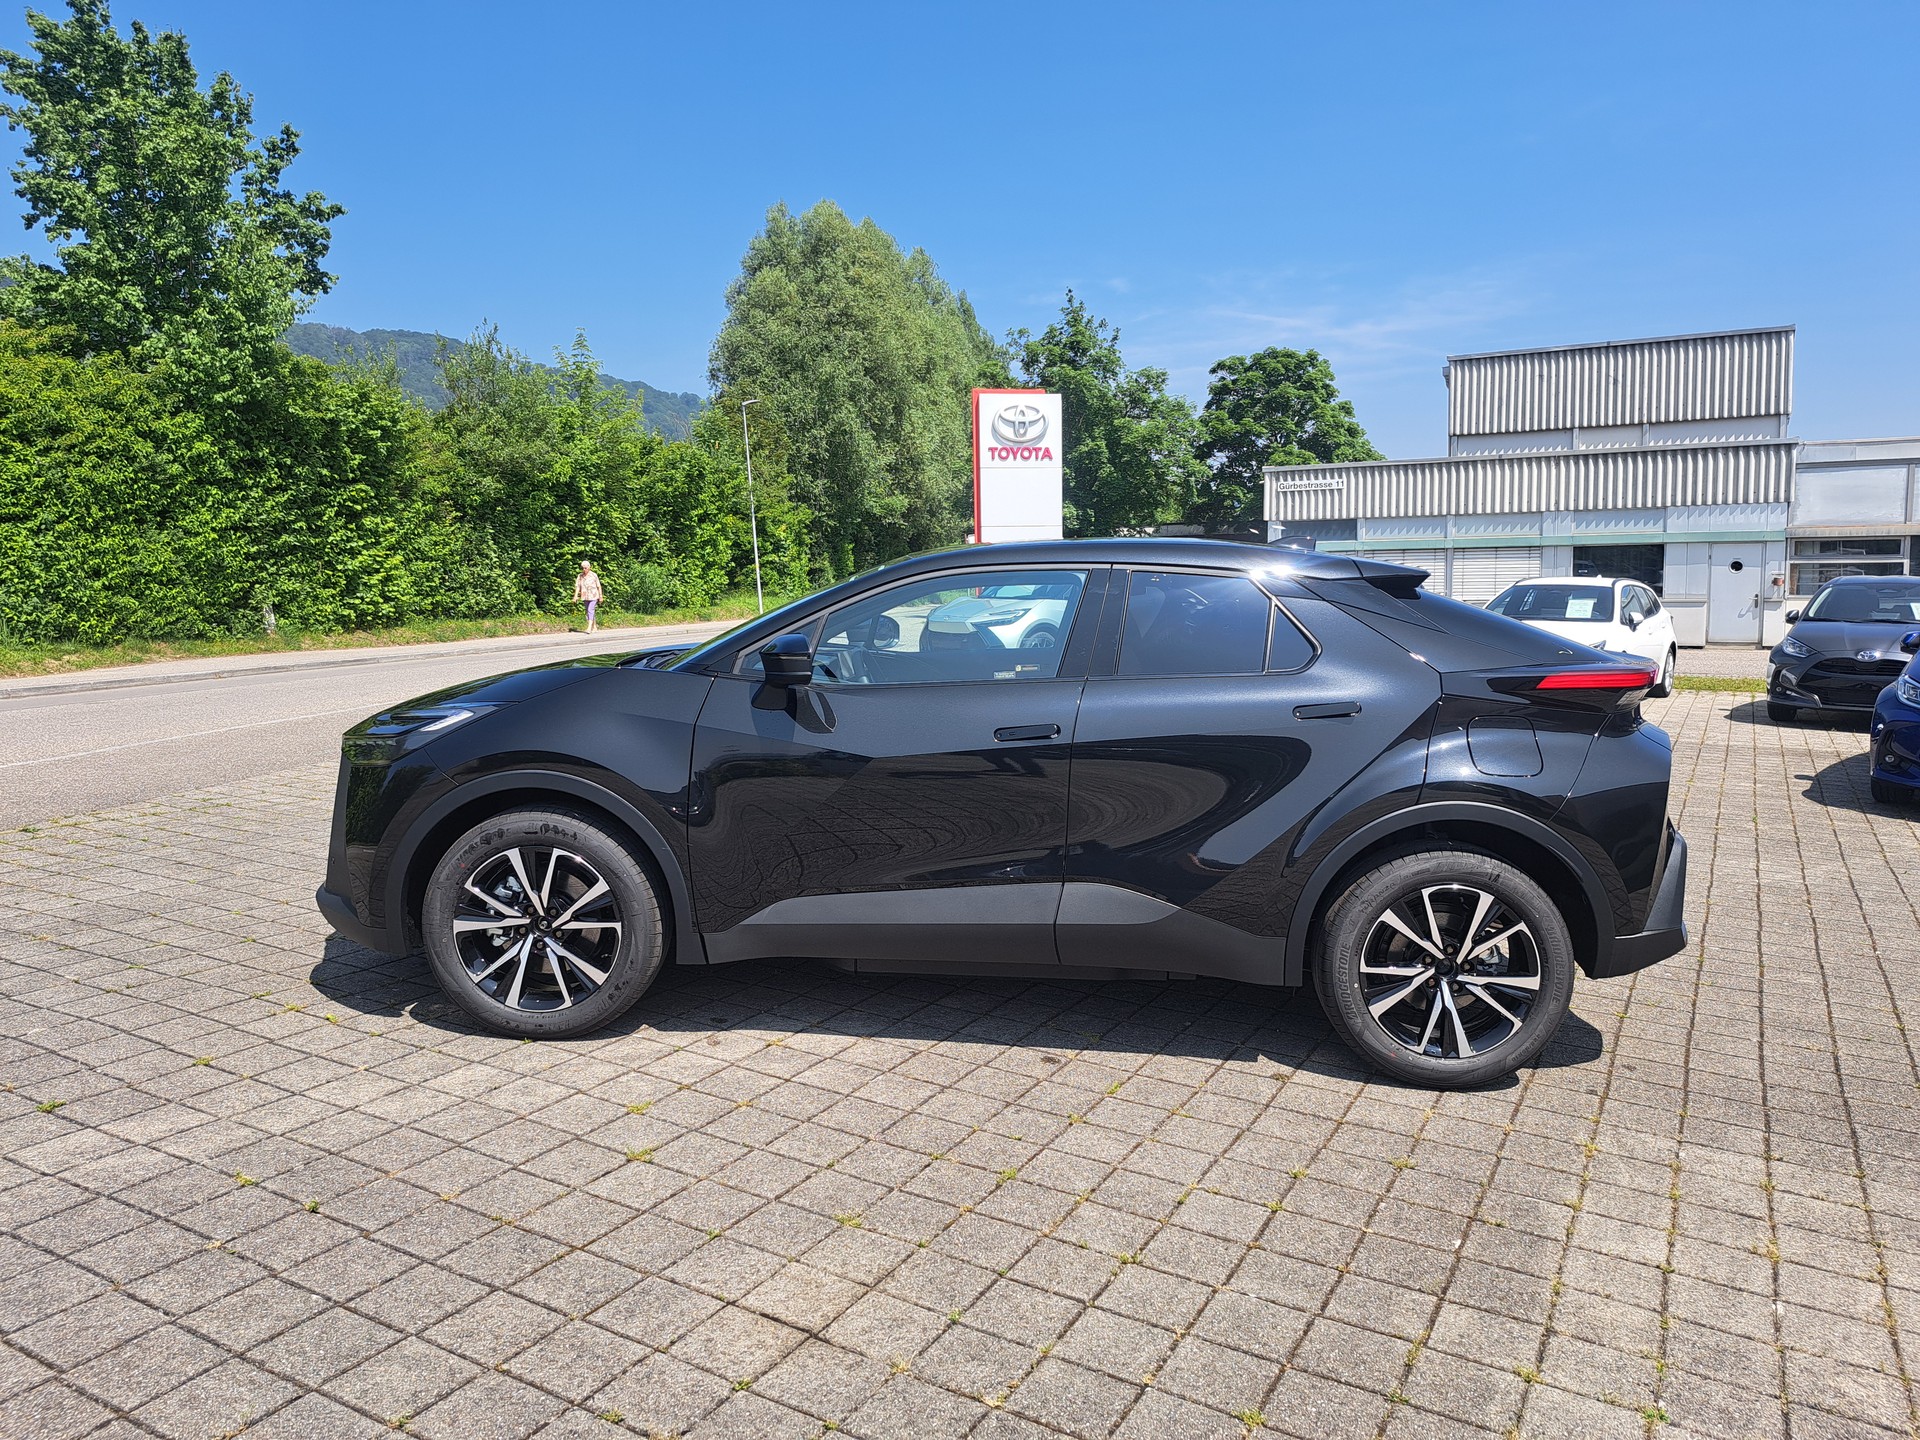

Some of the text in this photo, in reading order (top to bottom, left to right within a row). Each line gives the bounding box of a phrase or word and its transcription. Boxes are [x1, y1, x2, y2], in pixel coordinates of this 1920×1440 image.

[988, 446, 1053, 461] TOYOTA
[1279, 480, 1344, 490] Gürbestrasse 11
[1336, 941, 1359, 1022] BRIDGESTONE
